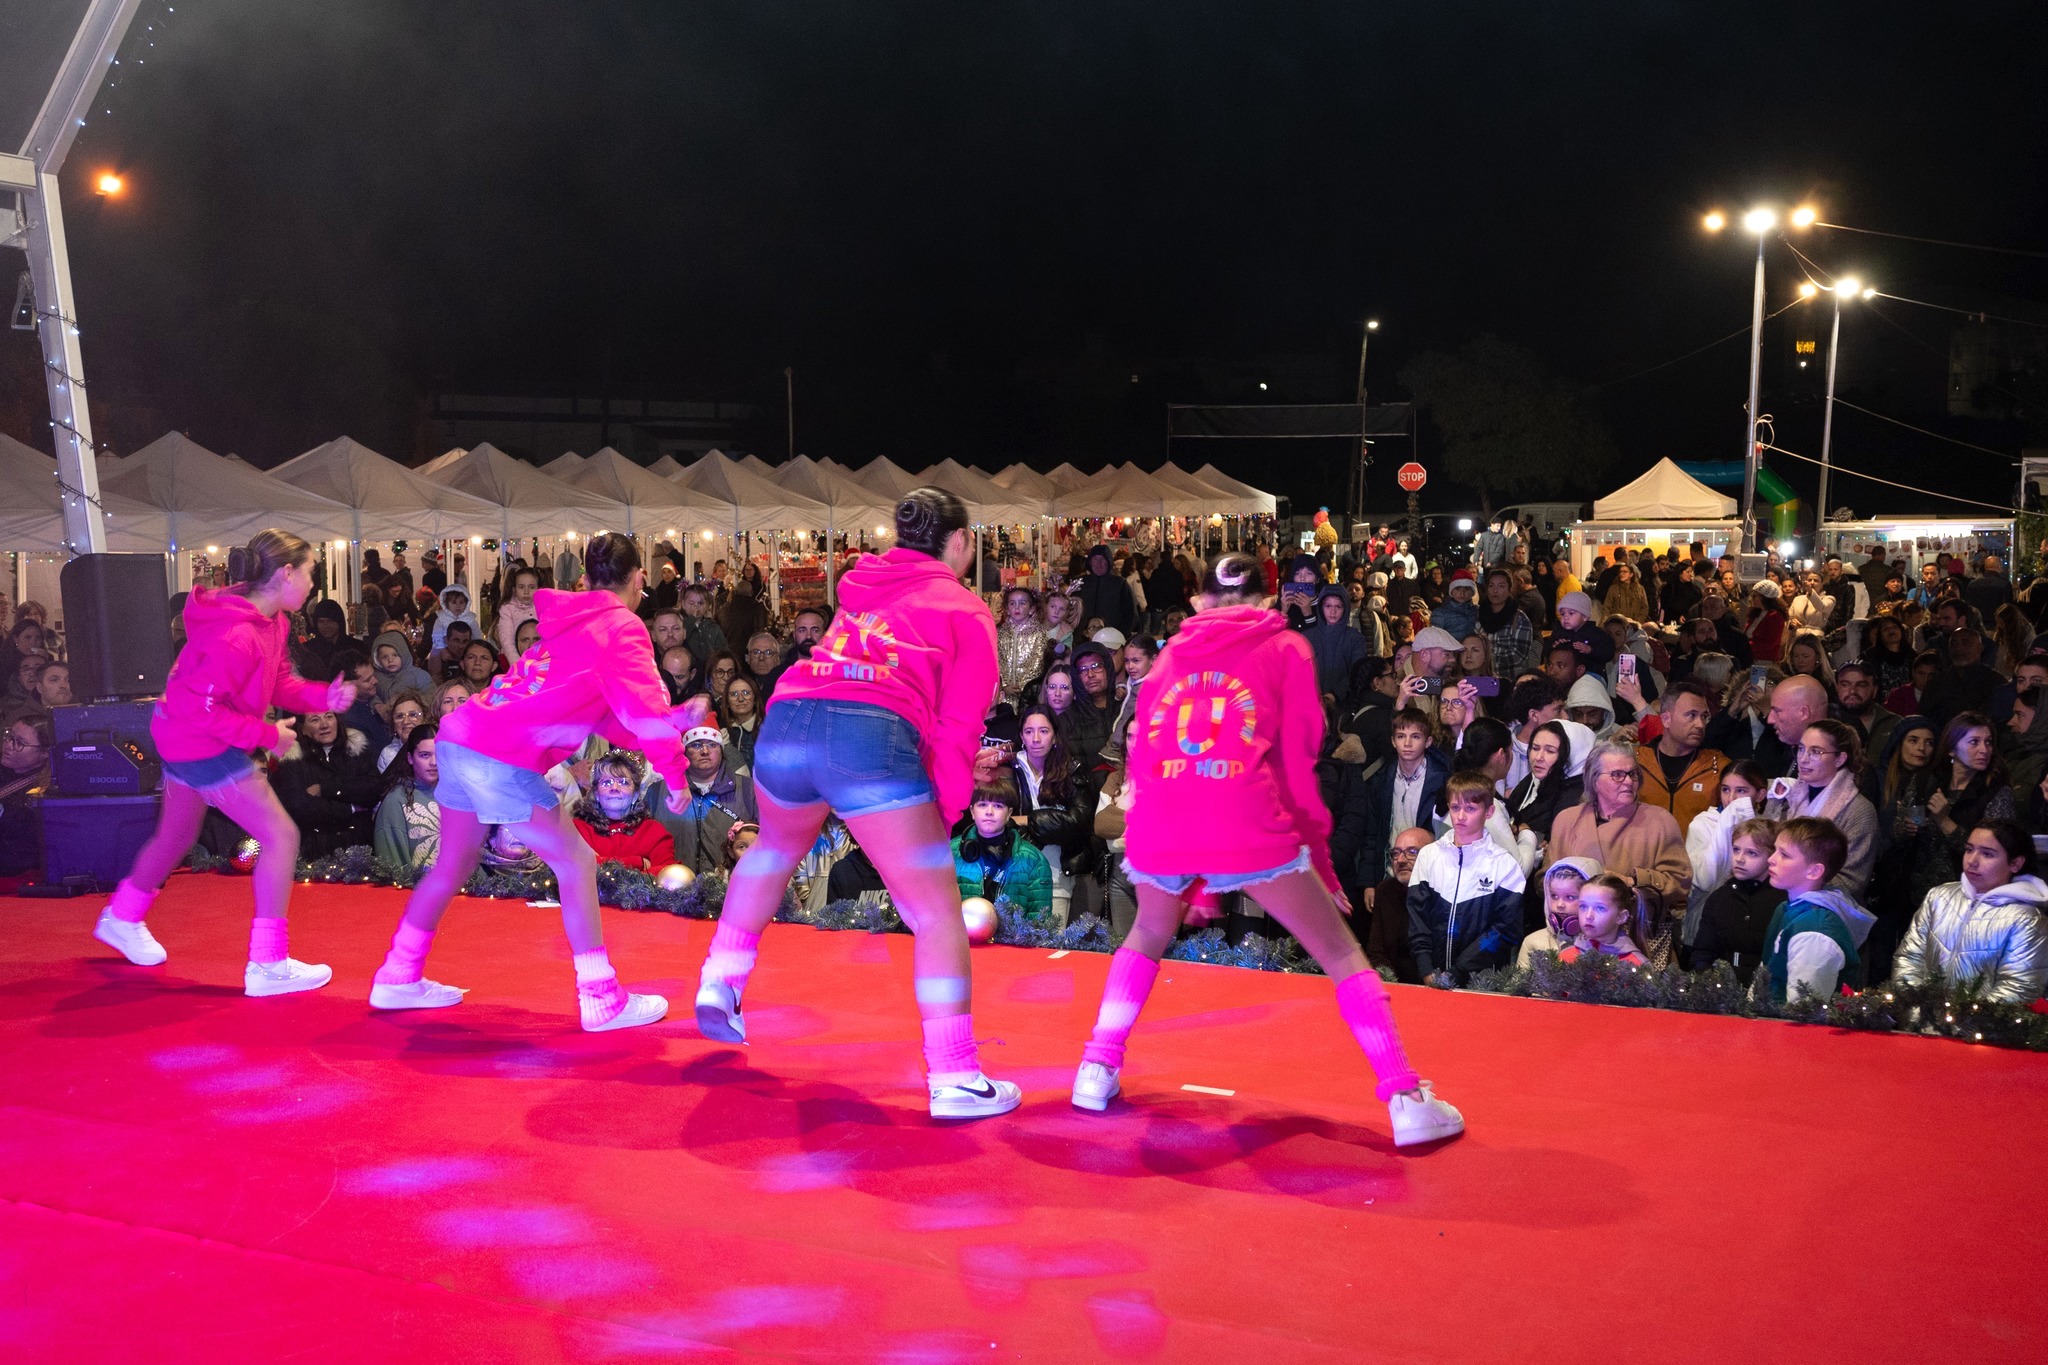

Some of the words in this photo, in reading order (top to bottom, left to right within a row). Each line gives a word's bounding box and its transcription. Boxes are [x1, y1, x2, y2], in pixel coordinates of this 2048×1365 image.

[1400, 472, 1424, 481] STOP
[843, 662, 890, 682] HOP
[1177, 697, 1226, 756] U
[1152, 758, 1187, 779] IP
[1195, 758, 1244, 779] HOP
